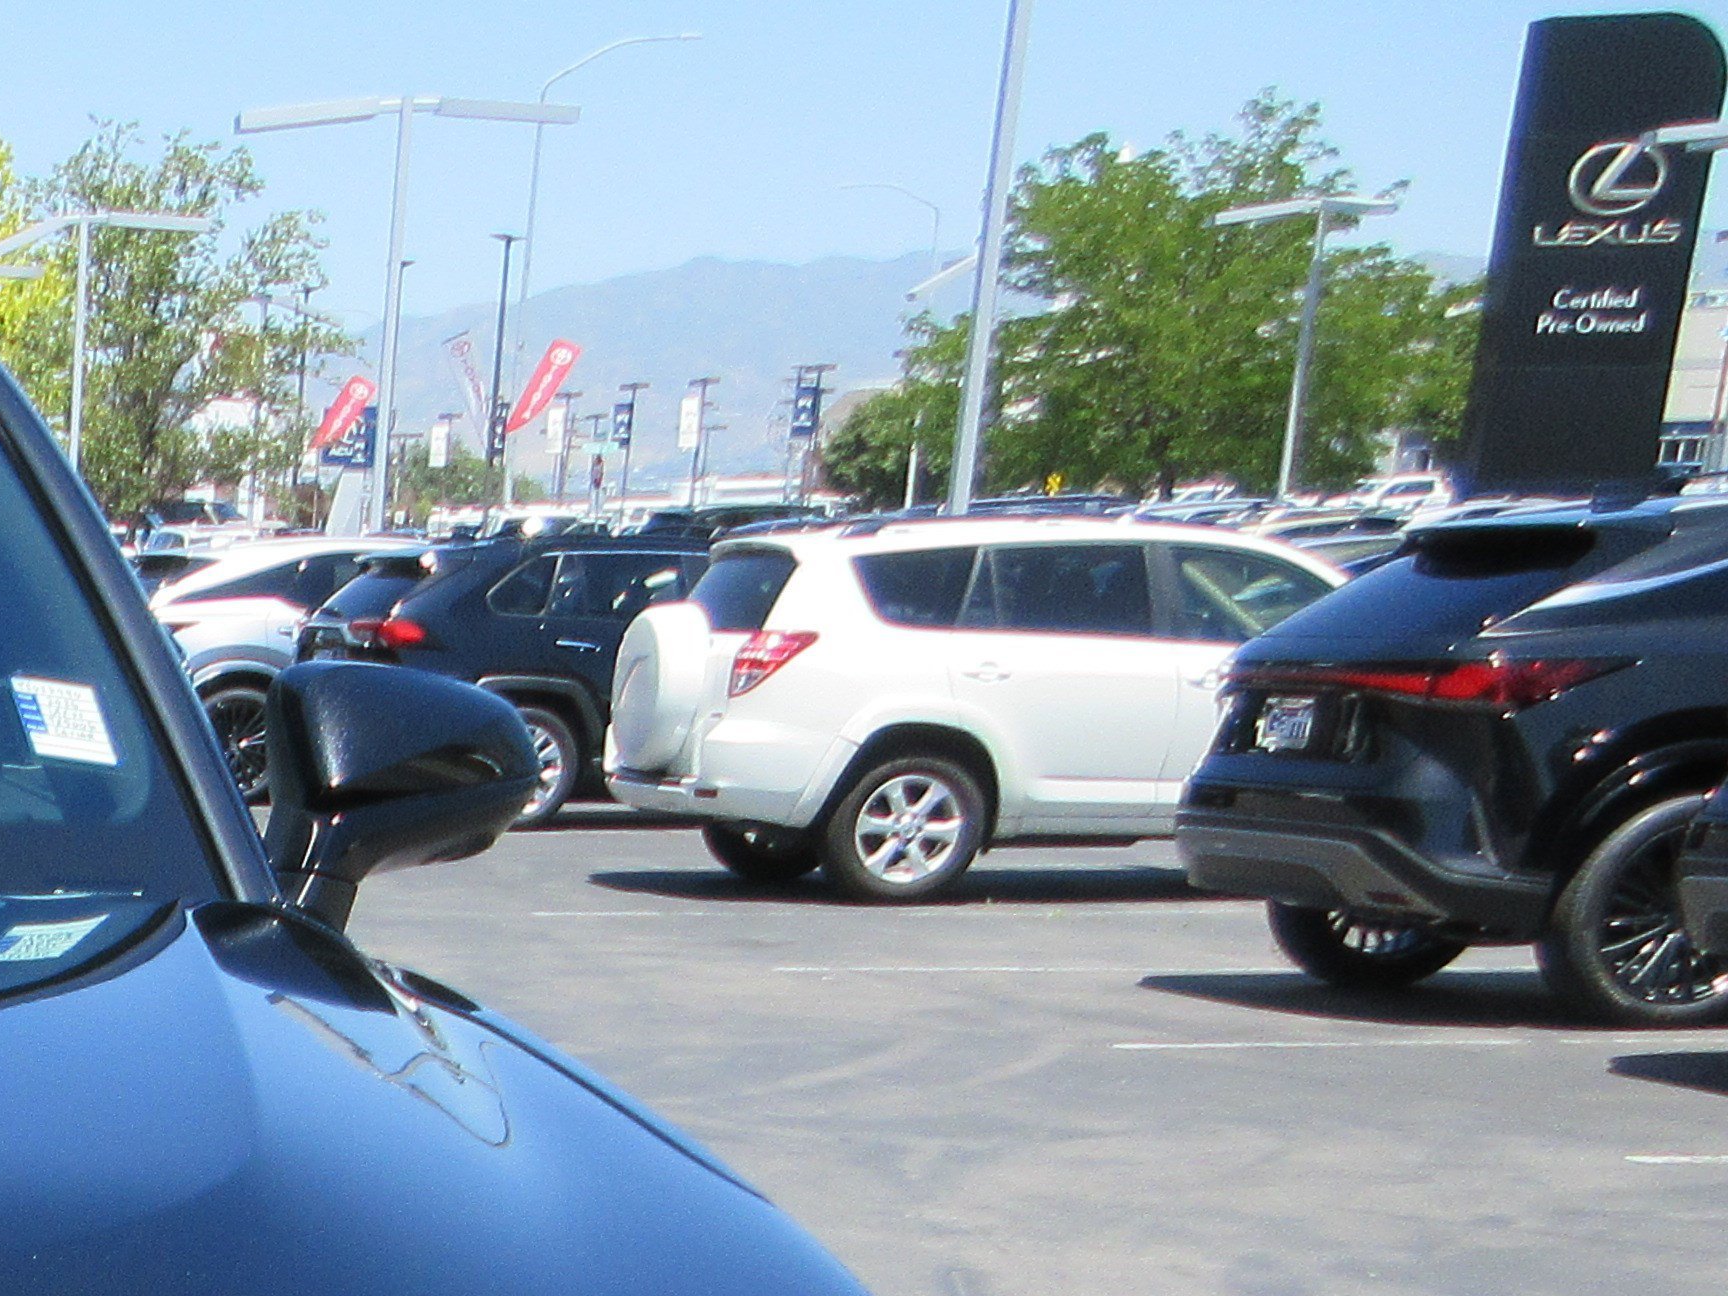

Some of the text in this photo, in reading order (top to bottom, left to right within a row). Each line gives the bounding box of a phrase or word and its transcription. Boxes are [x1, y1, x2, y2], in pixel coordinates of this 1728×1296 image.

[1531, 219, 1682, 247] LEXUS
[1552, 285, 1642, 310] Certified
[1536, 311, 1648, 335] Pre-Owned
